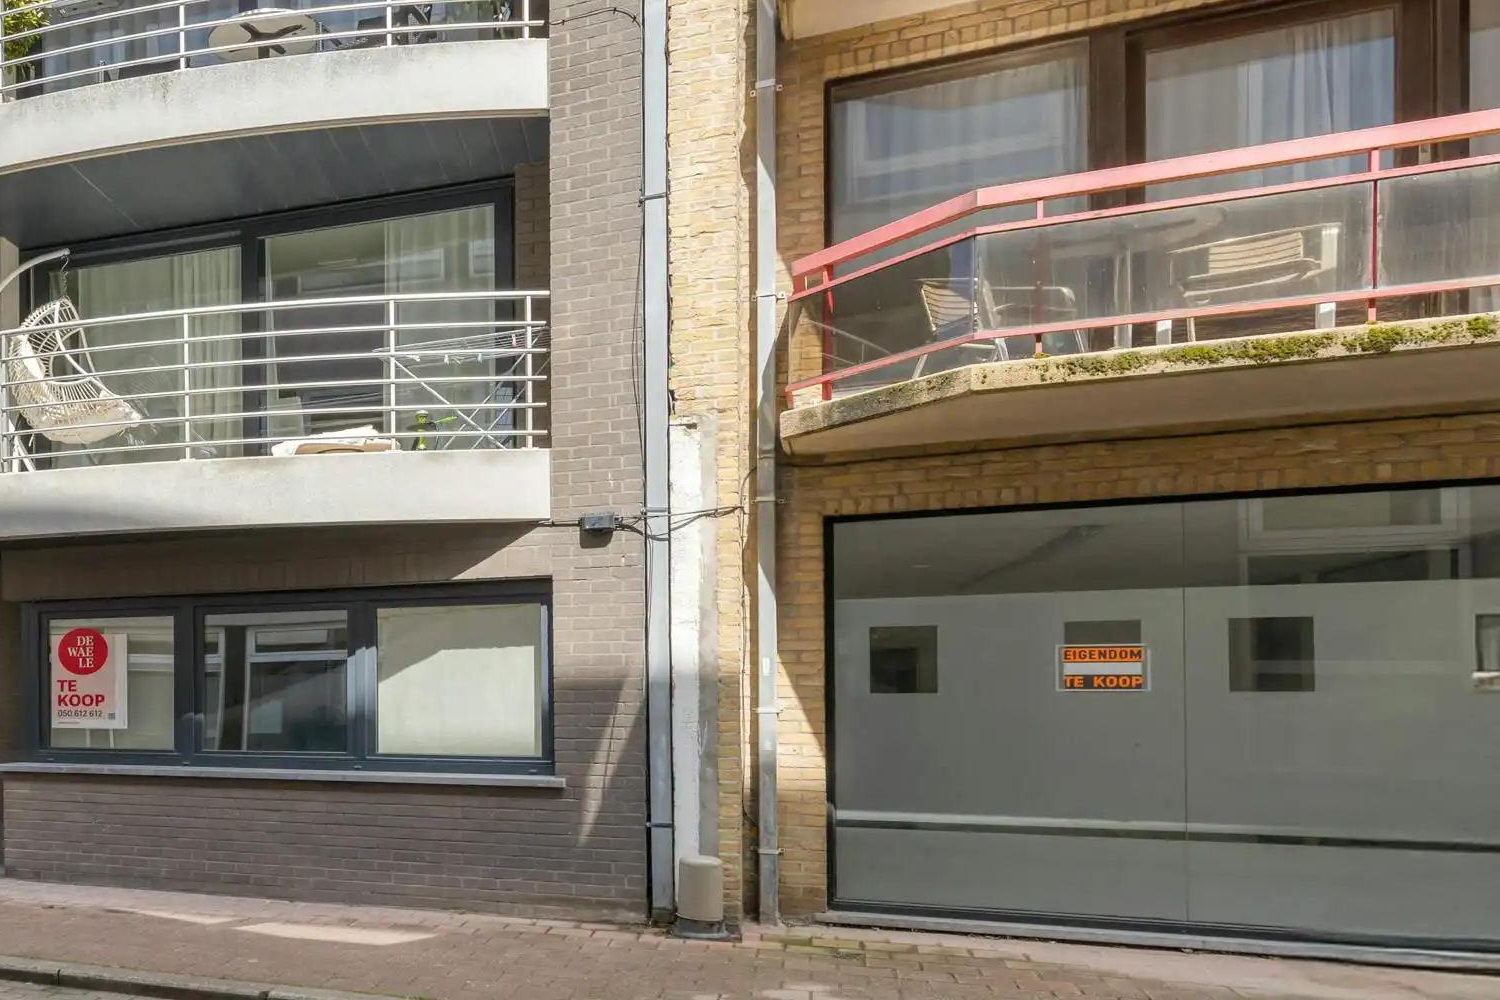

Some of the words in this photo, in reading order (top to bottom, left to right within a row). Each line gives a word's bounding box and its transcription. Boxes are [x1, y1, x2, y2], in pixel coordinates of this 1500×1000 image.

[76, 636, 94, 646] DE
[67, 647, 94, 657] WAE
[1064, 649, 1142, 660] EIGENDOM
[79, 658, 94, 668] LE
[56, 680, 77, 692] TE
[1064, 676, 1084, 688] TE
[1093, 675, 1144, 688] KOOP
[57, 694, 105, 706] KOOP
[57, 709, 73, 717] 050
[74, 709, 88, 717] 612
[89, 709, 103, 717] 612
